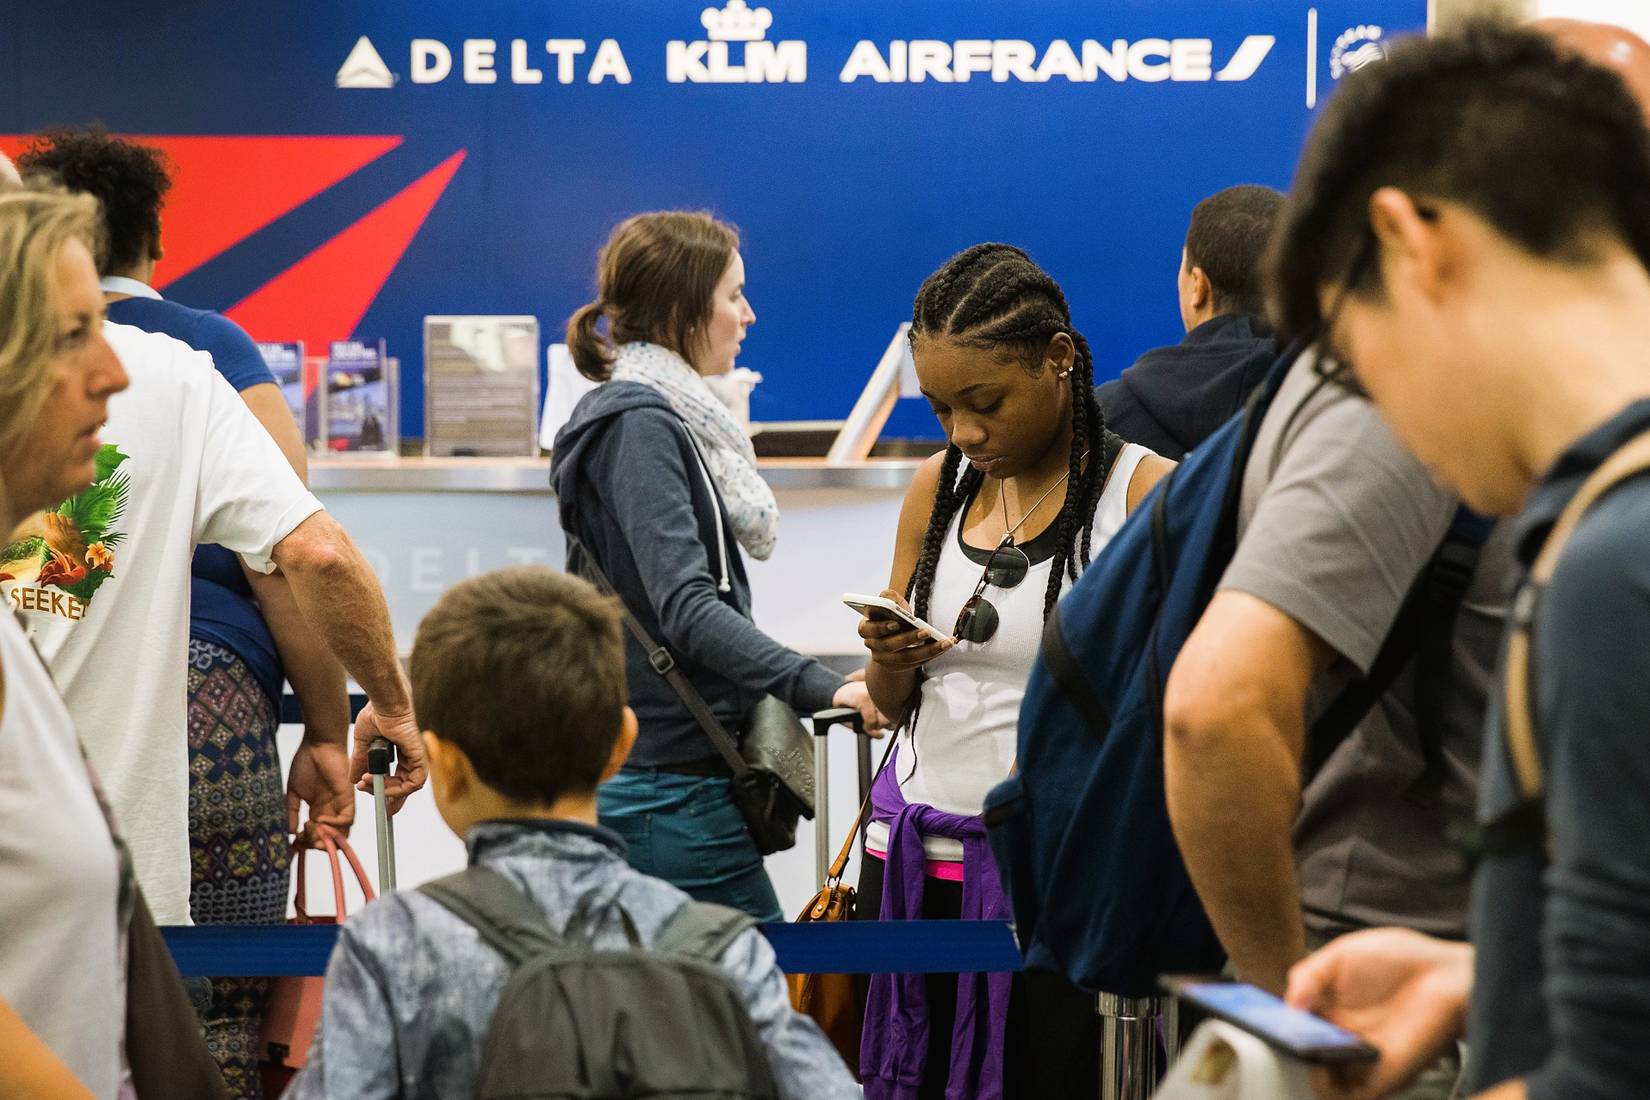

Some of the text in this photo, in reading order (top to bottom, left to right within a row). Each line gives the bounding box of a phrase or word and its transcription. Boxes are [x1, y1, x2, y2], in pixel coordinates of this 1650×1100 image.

[410, 39, 1212, 84] DELTA KLM AIRFRANCE
[10, 587, 87, 621] SEEKE
